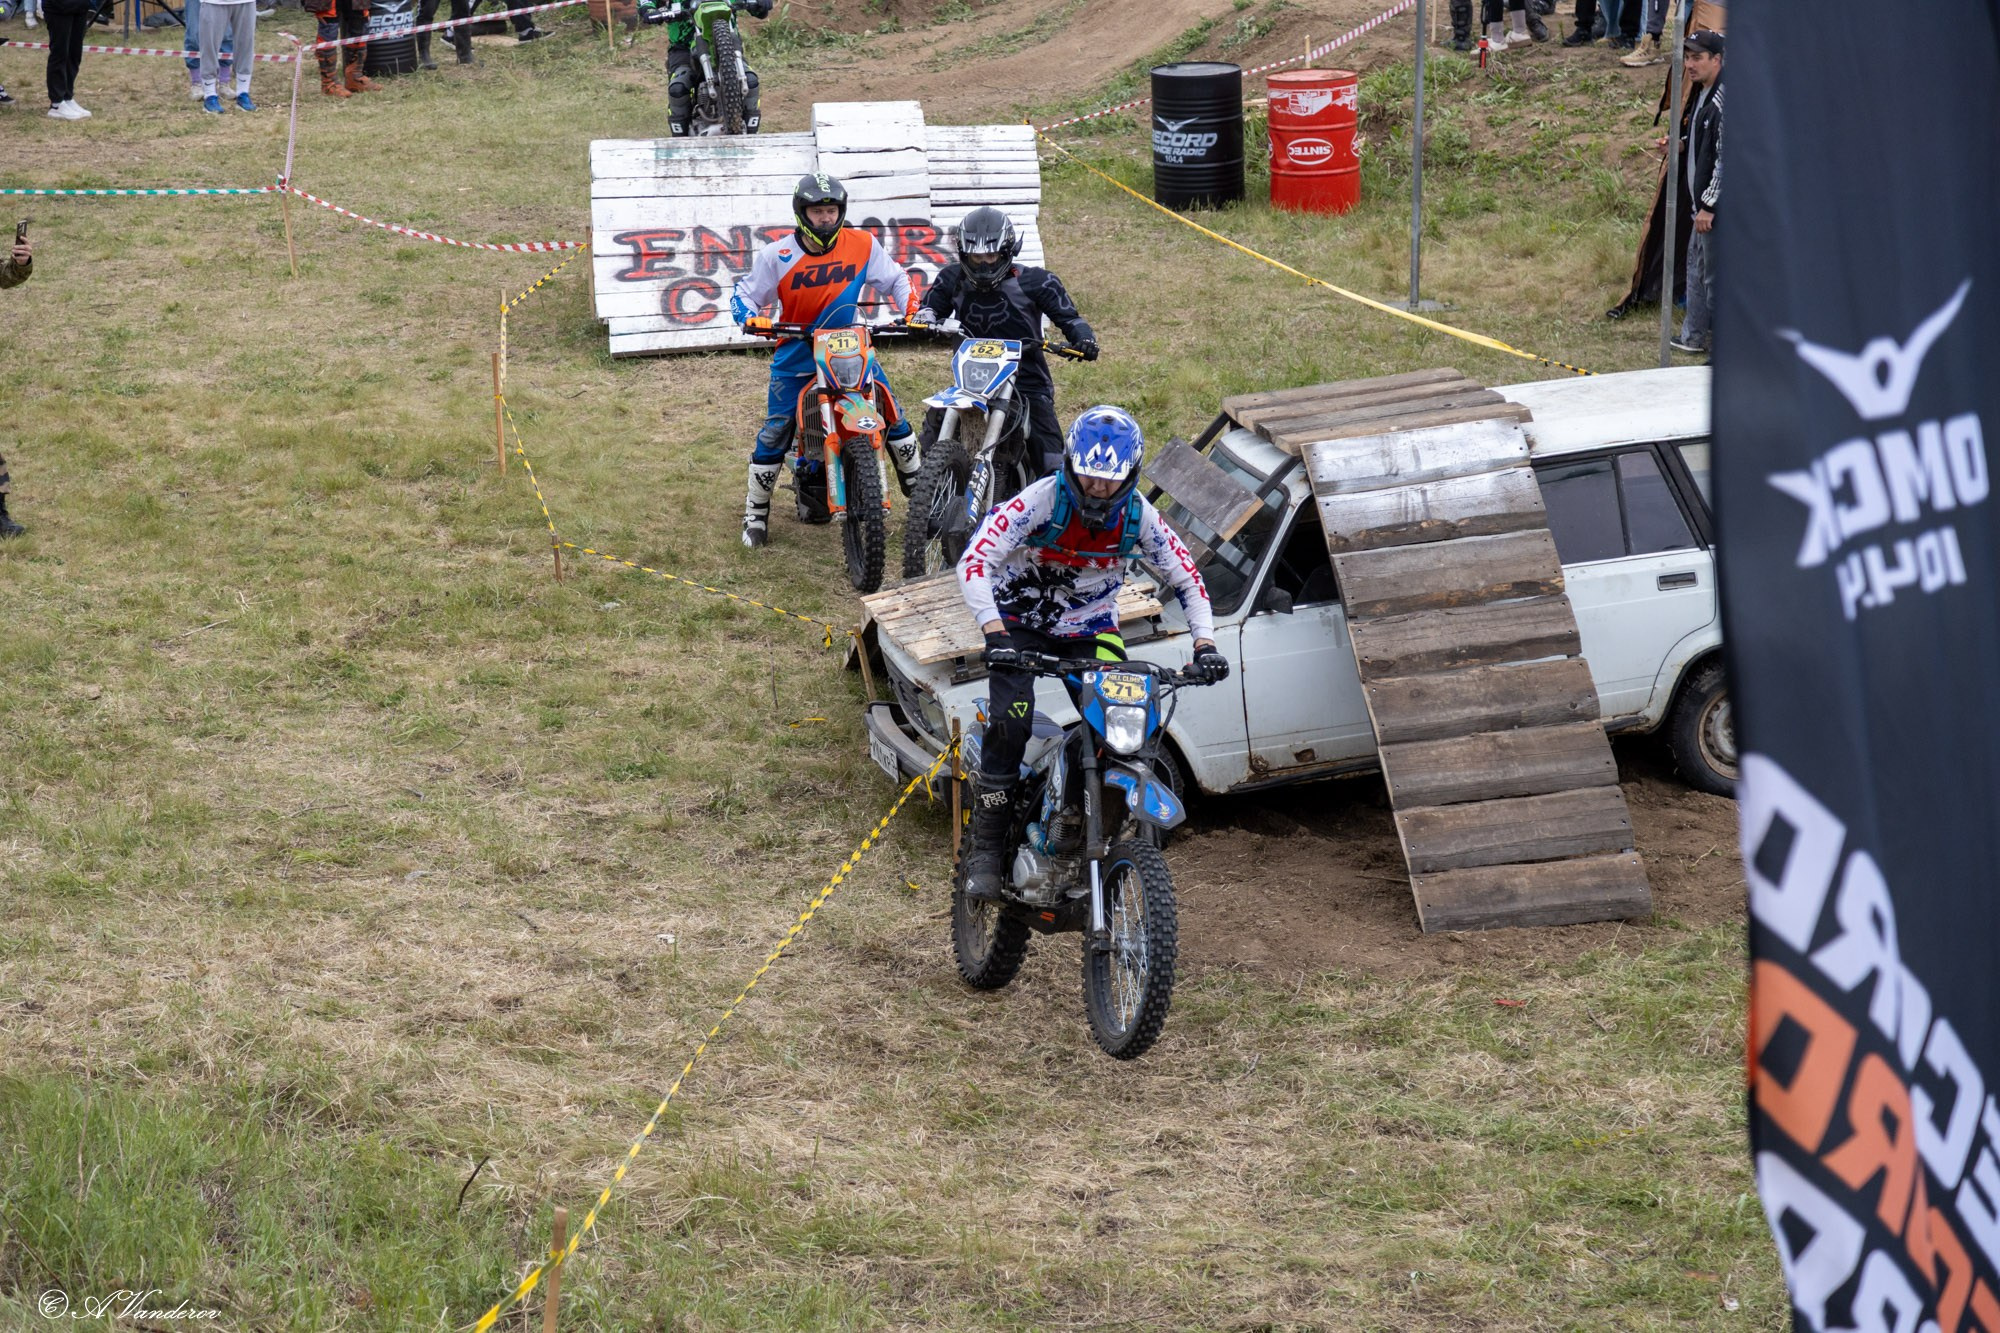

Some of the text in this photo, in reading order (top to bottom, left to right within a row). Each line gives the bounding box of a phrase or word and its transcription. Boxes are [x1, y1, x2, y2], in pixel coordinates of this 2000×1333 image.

[369, 11, 414, 27] ECOR
[1152, 128, 1218, 148] ECORD
[1173, 147, 1207, 156] RADIO
[1289, 145, 1331, 156] SINTEC
[1165, 155, 1184, 163] 104.4
[790, 261, 856, 290] KTM
[837, 339, 849, 348] 11
[977, 345, 995, 355] 62
[1114, 683, 1132, 697] 71
